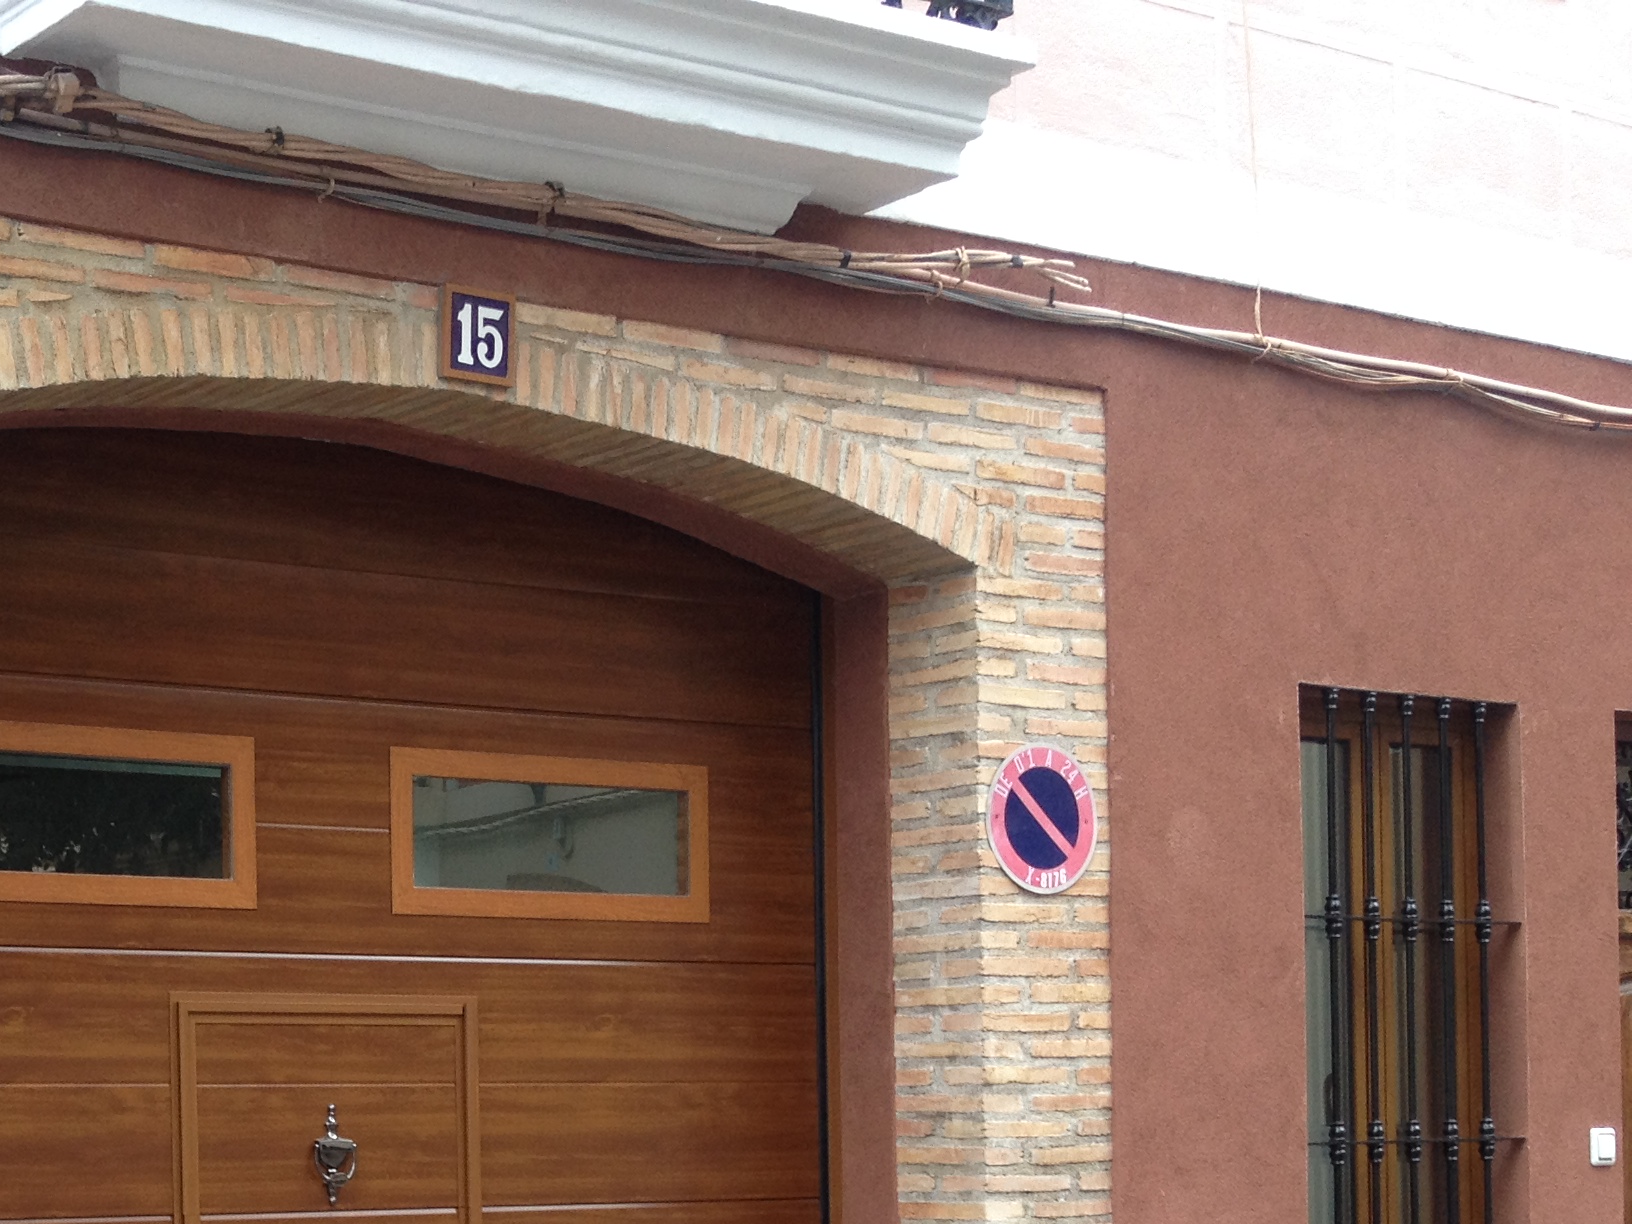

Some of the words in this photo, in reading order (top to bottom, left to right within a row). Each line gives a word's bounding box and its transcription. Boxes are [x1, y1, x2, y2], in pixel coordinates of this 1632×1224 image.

[457, 302, 504, 368] 15
[994, 772, 1013, 798] DE
[1045, 750, 1053, 767] A
[1060, 759, 1080, 784] 24
[1075, 786, 1088, 800] H
